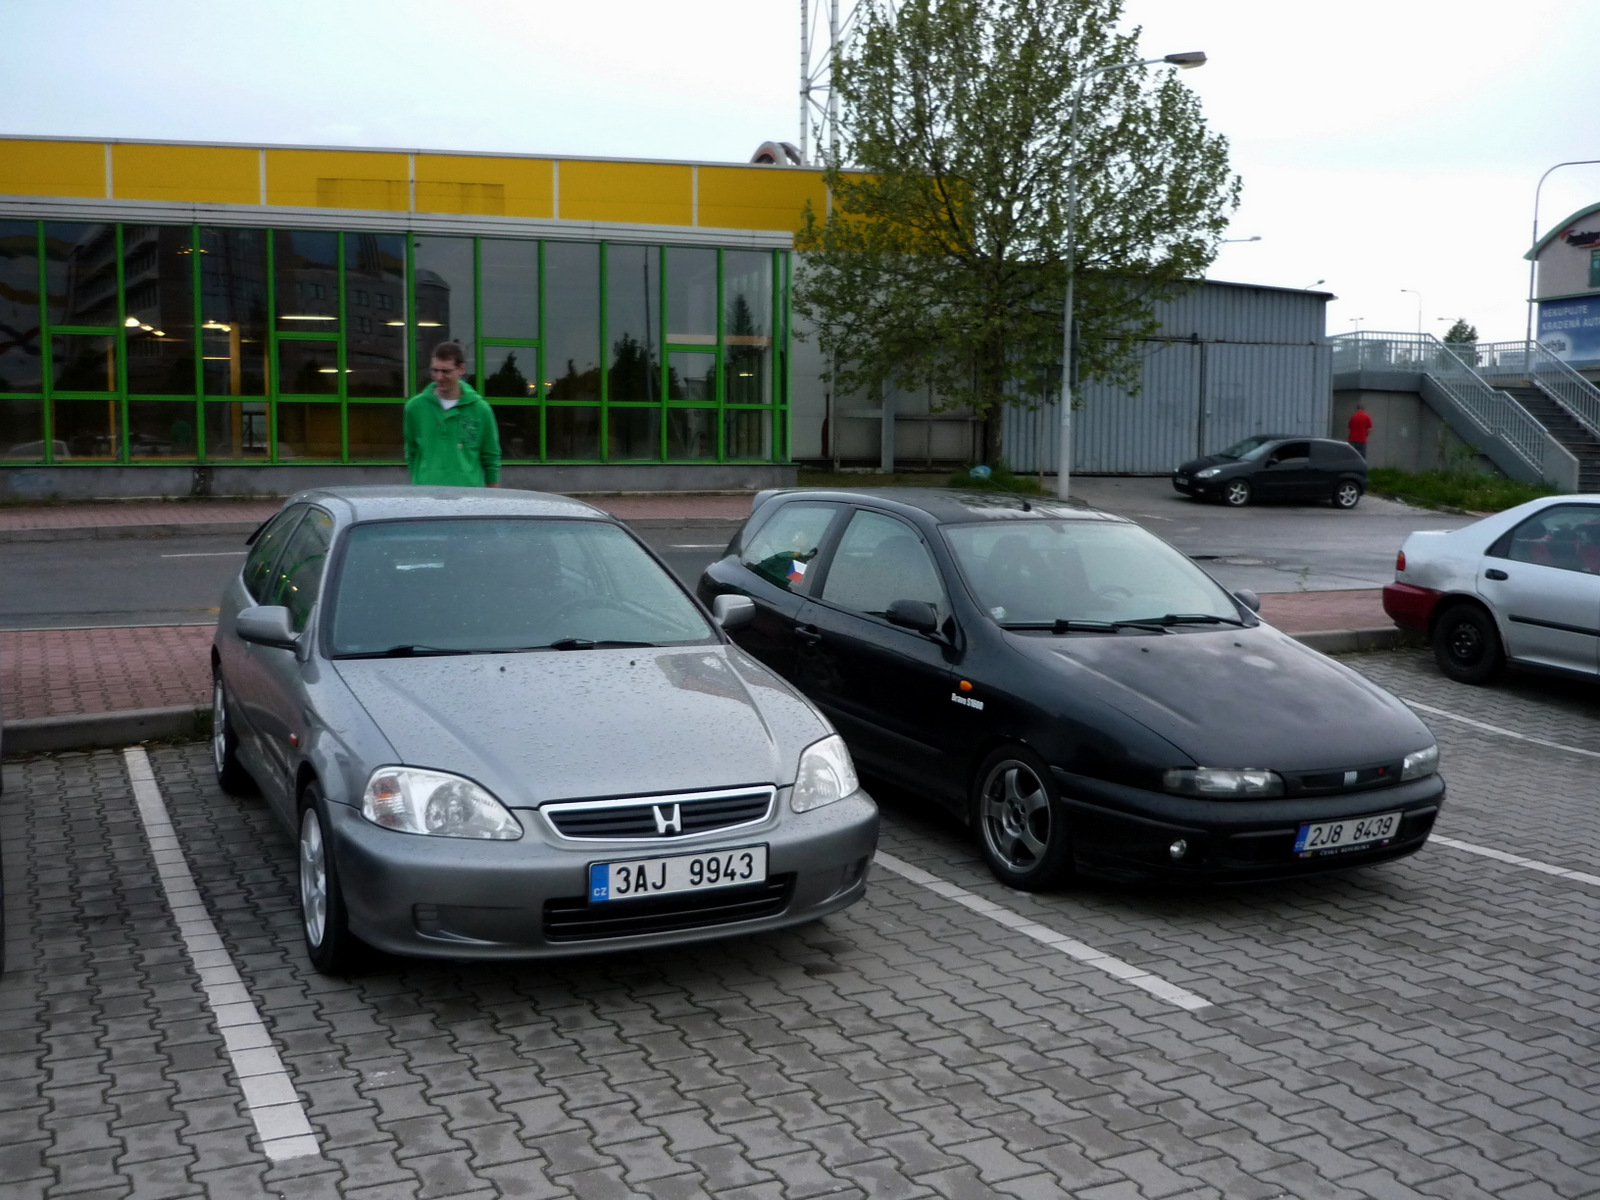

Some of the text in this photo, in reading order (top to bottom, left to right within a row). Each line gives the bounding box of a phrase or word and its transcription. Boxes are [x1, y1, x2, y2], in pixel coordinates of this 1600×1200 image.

[1309, 816, 1393, 846] 2J8 8439
[615, 852, 754, 894] 3AJ 9943
[593, 886, 607, 897] CZ
